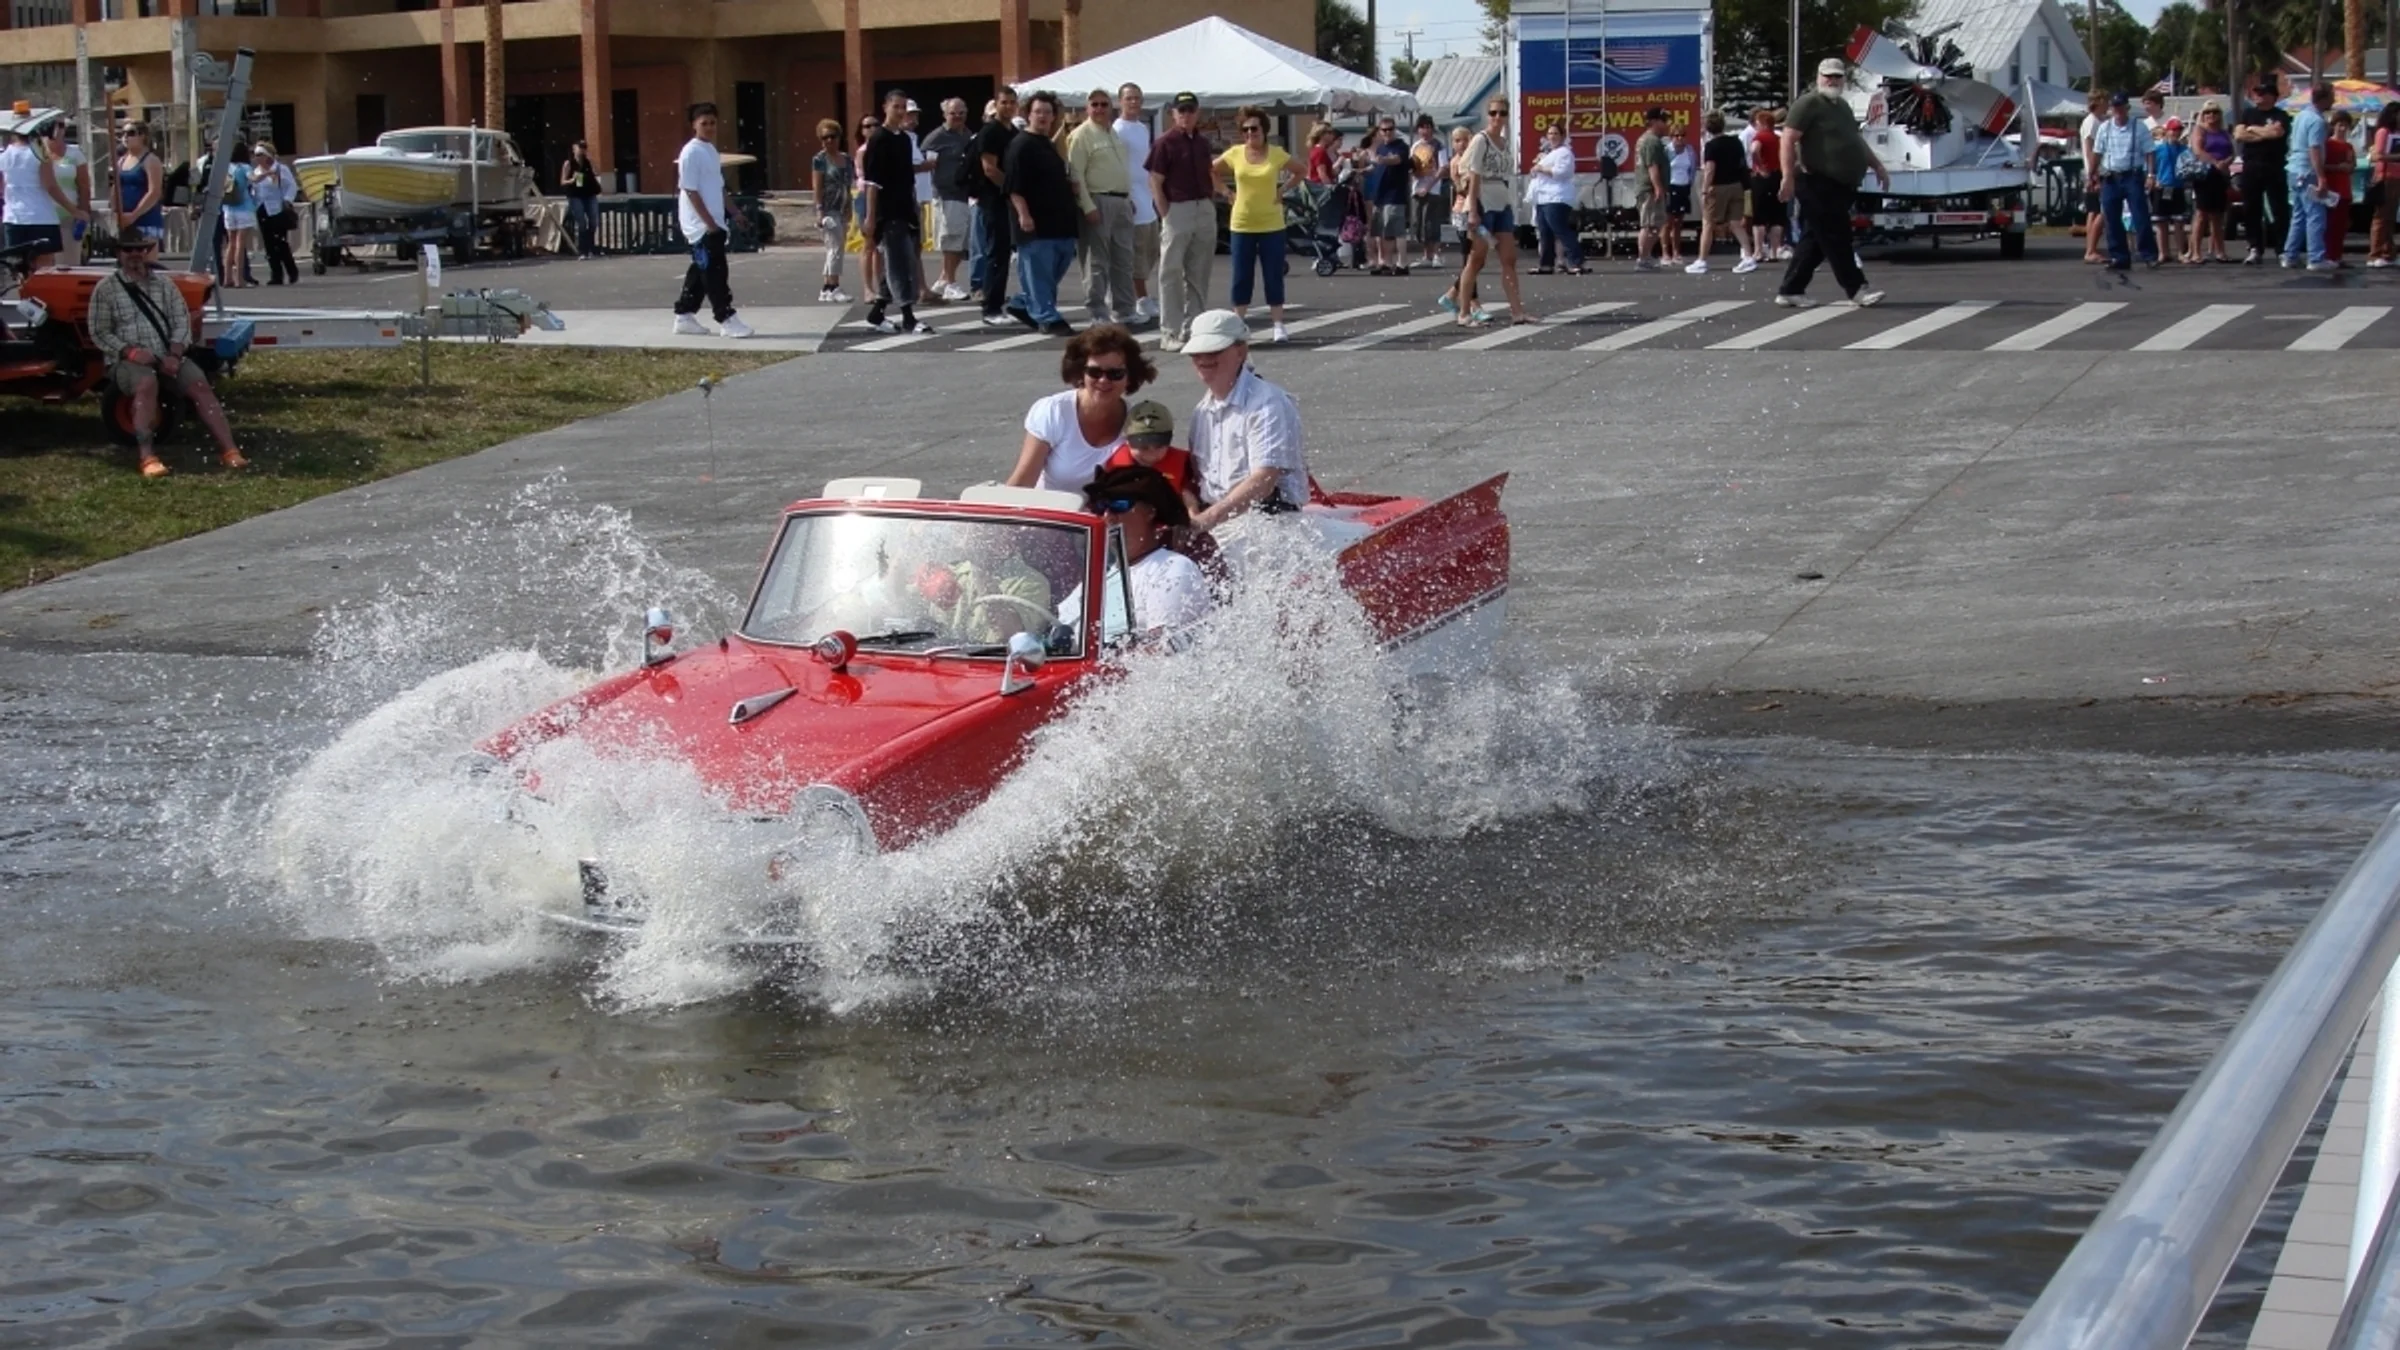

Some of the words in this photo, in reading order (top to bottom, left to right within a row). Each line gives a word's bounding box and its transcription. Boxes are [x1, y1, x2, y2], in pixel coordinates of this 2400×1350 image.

[1527, 96, 1571, 107] Repor
[1574, 92, 1643, 106] Suspicious
[1647, 91, 1697, 104] Activity
[1533, 110, 1690, 131] 877-24WAH
